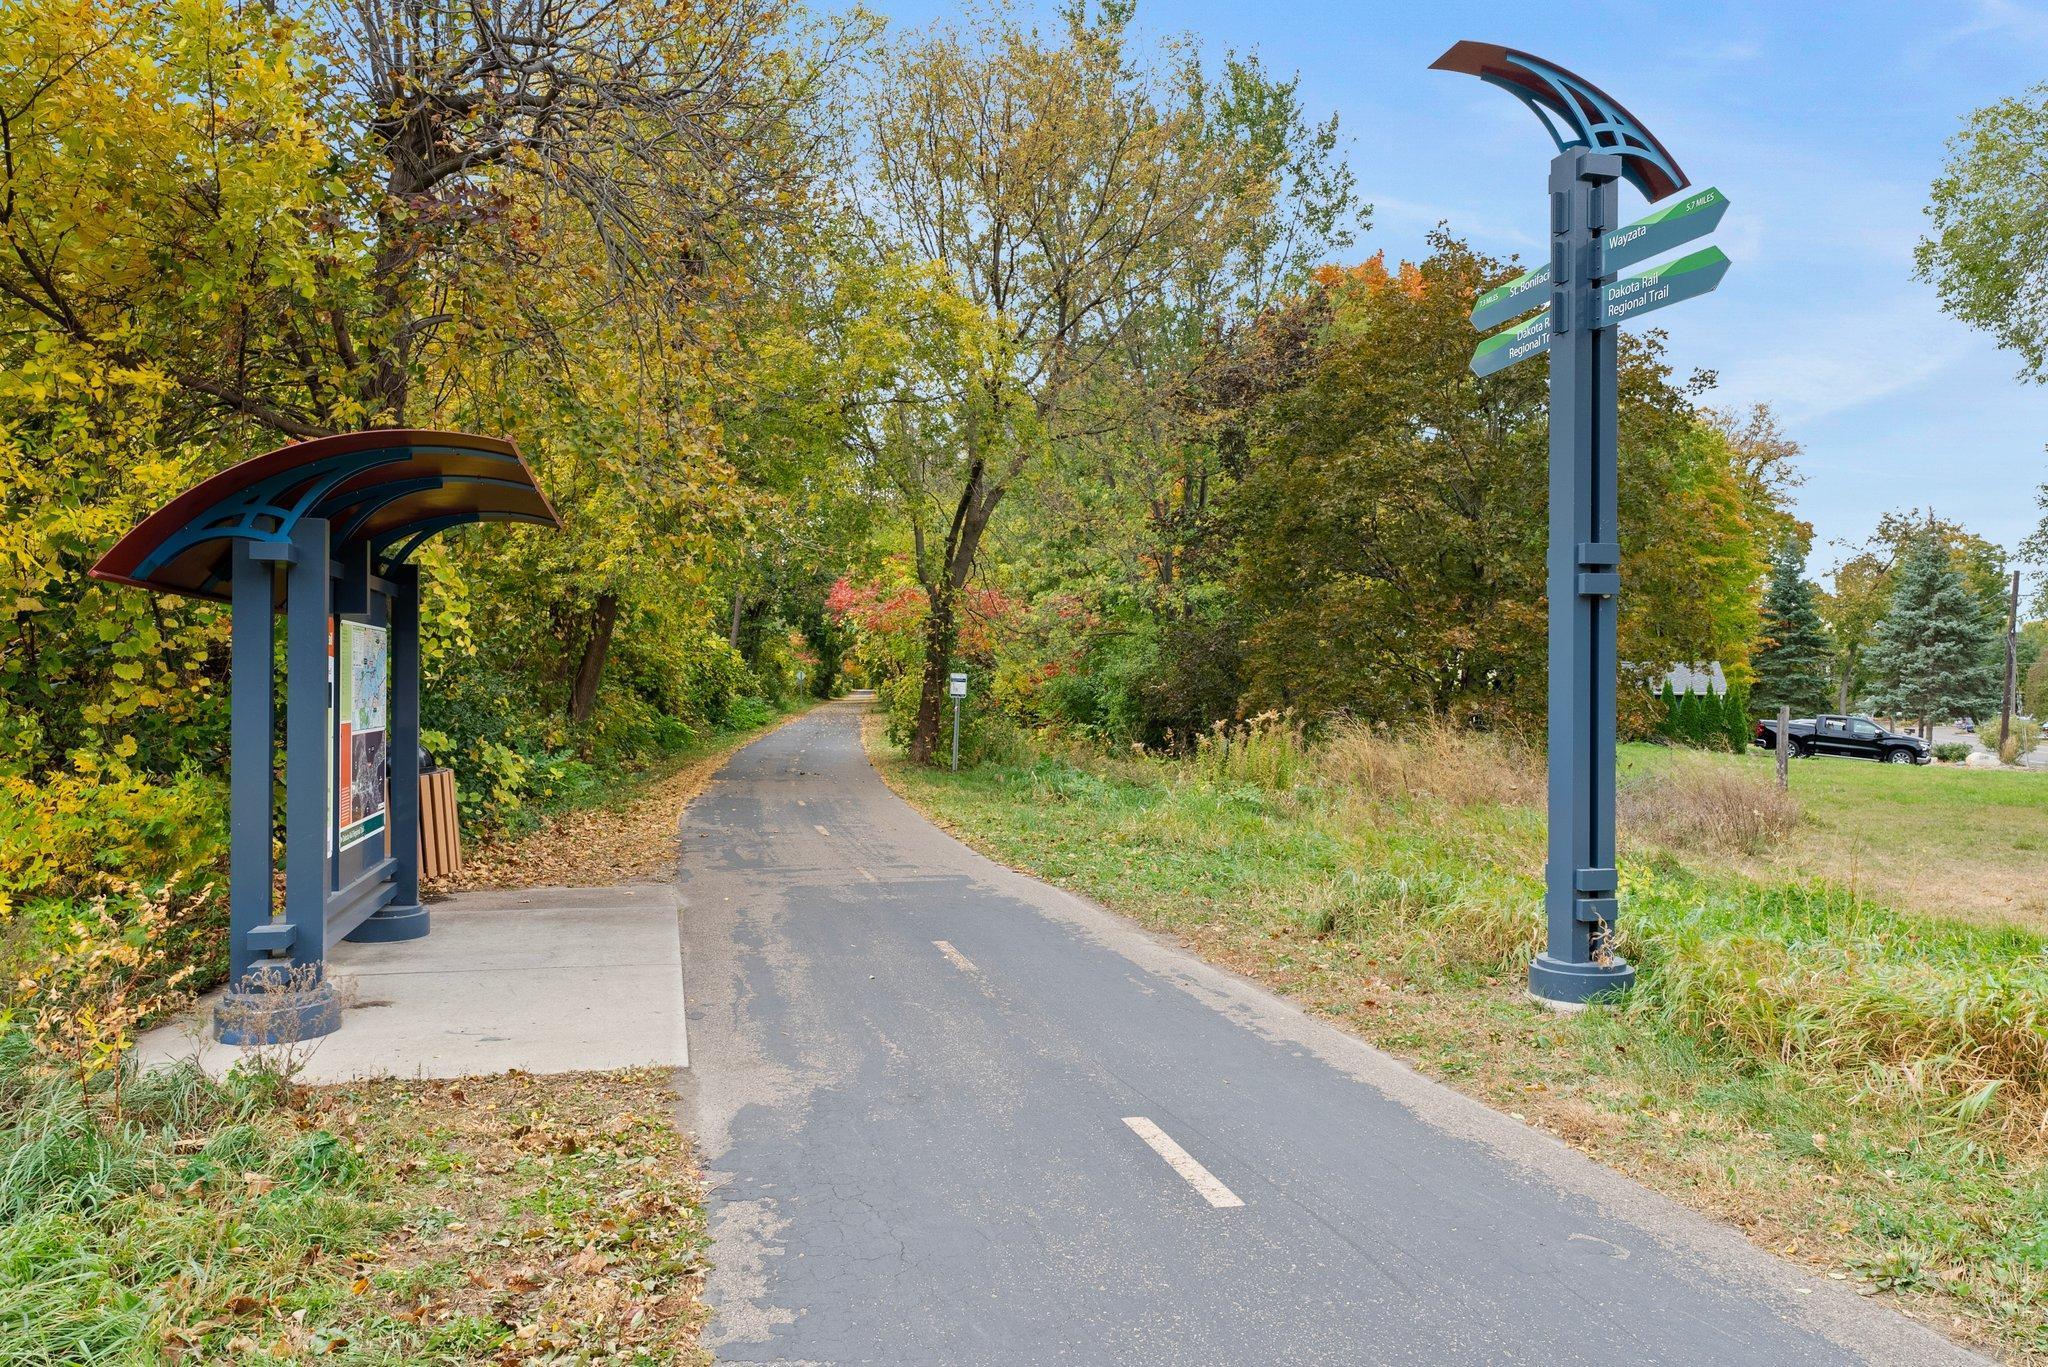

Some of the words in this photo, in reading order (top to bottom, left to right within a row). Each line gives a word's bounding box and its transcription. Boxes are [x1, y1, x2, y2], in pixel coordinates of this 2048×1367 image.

[1696, 192, 1715, 206] MILES
[1609, 225, 1647, 249] Wayzata
[1510, 286, 1519, 298] St.
[1521, 269, 1550, 292] Bonifaci
[1608, 282, 1640, 301] Dakota
[1642, 272, 1659, 289] Rail
[1486, 293, 1499, 305] MILES
[1608, 292, 1647, 316] Regional
[1649, 284, 1669, 302] Trail
[1517, 322, 1543, 341] Dakota
[1509, 336, 1541, 359] Regional
[1542, 332, 1550, 344] Tr
